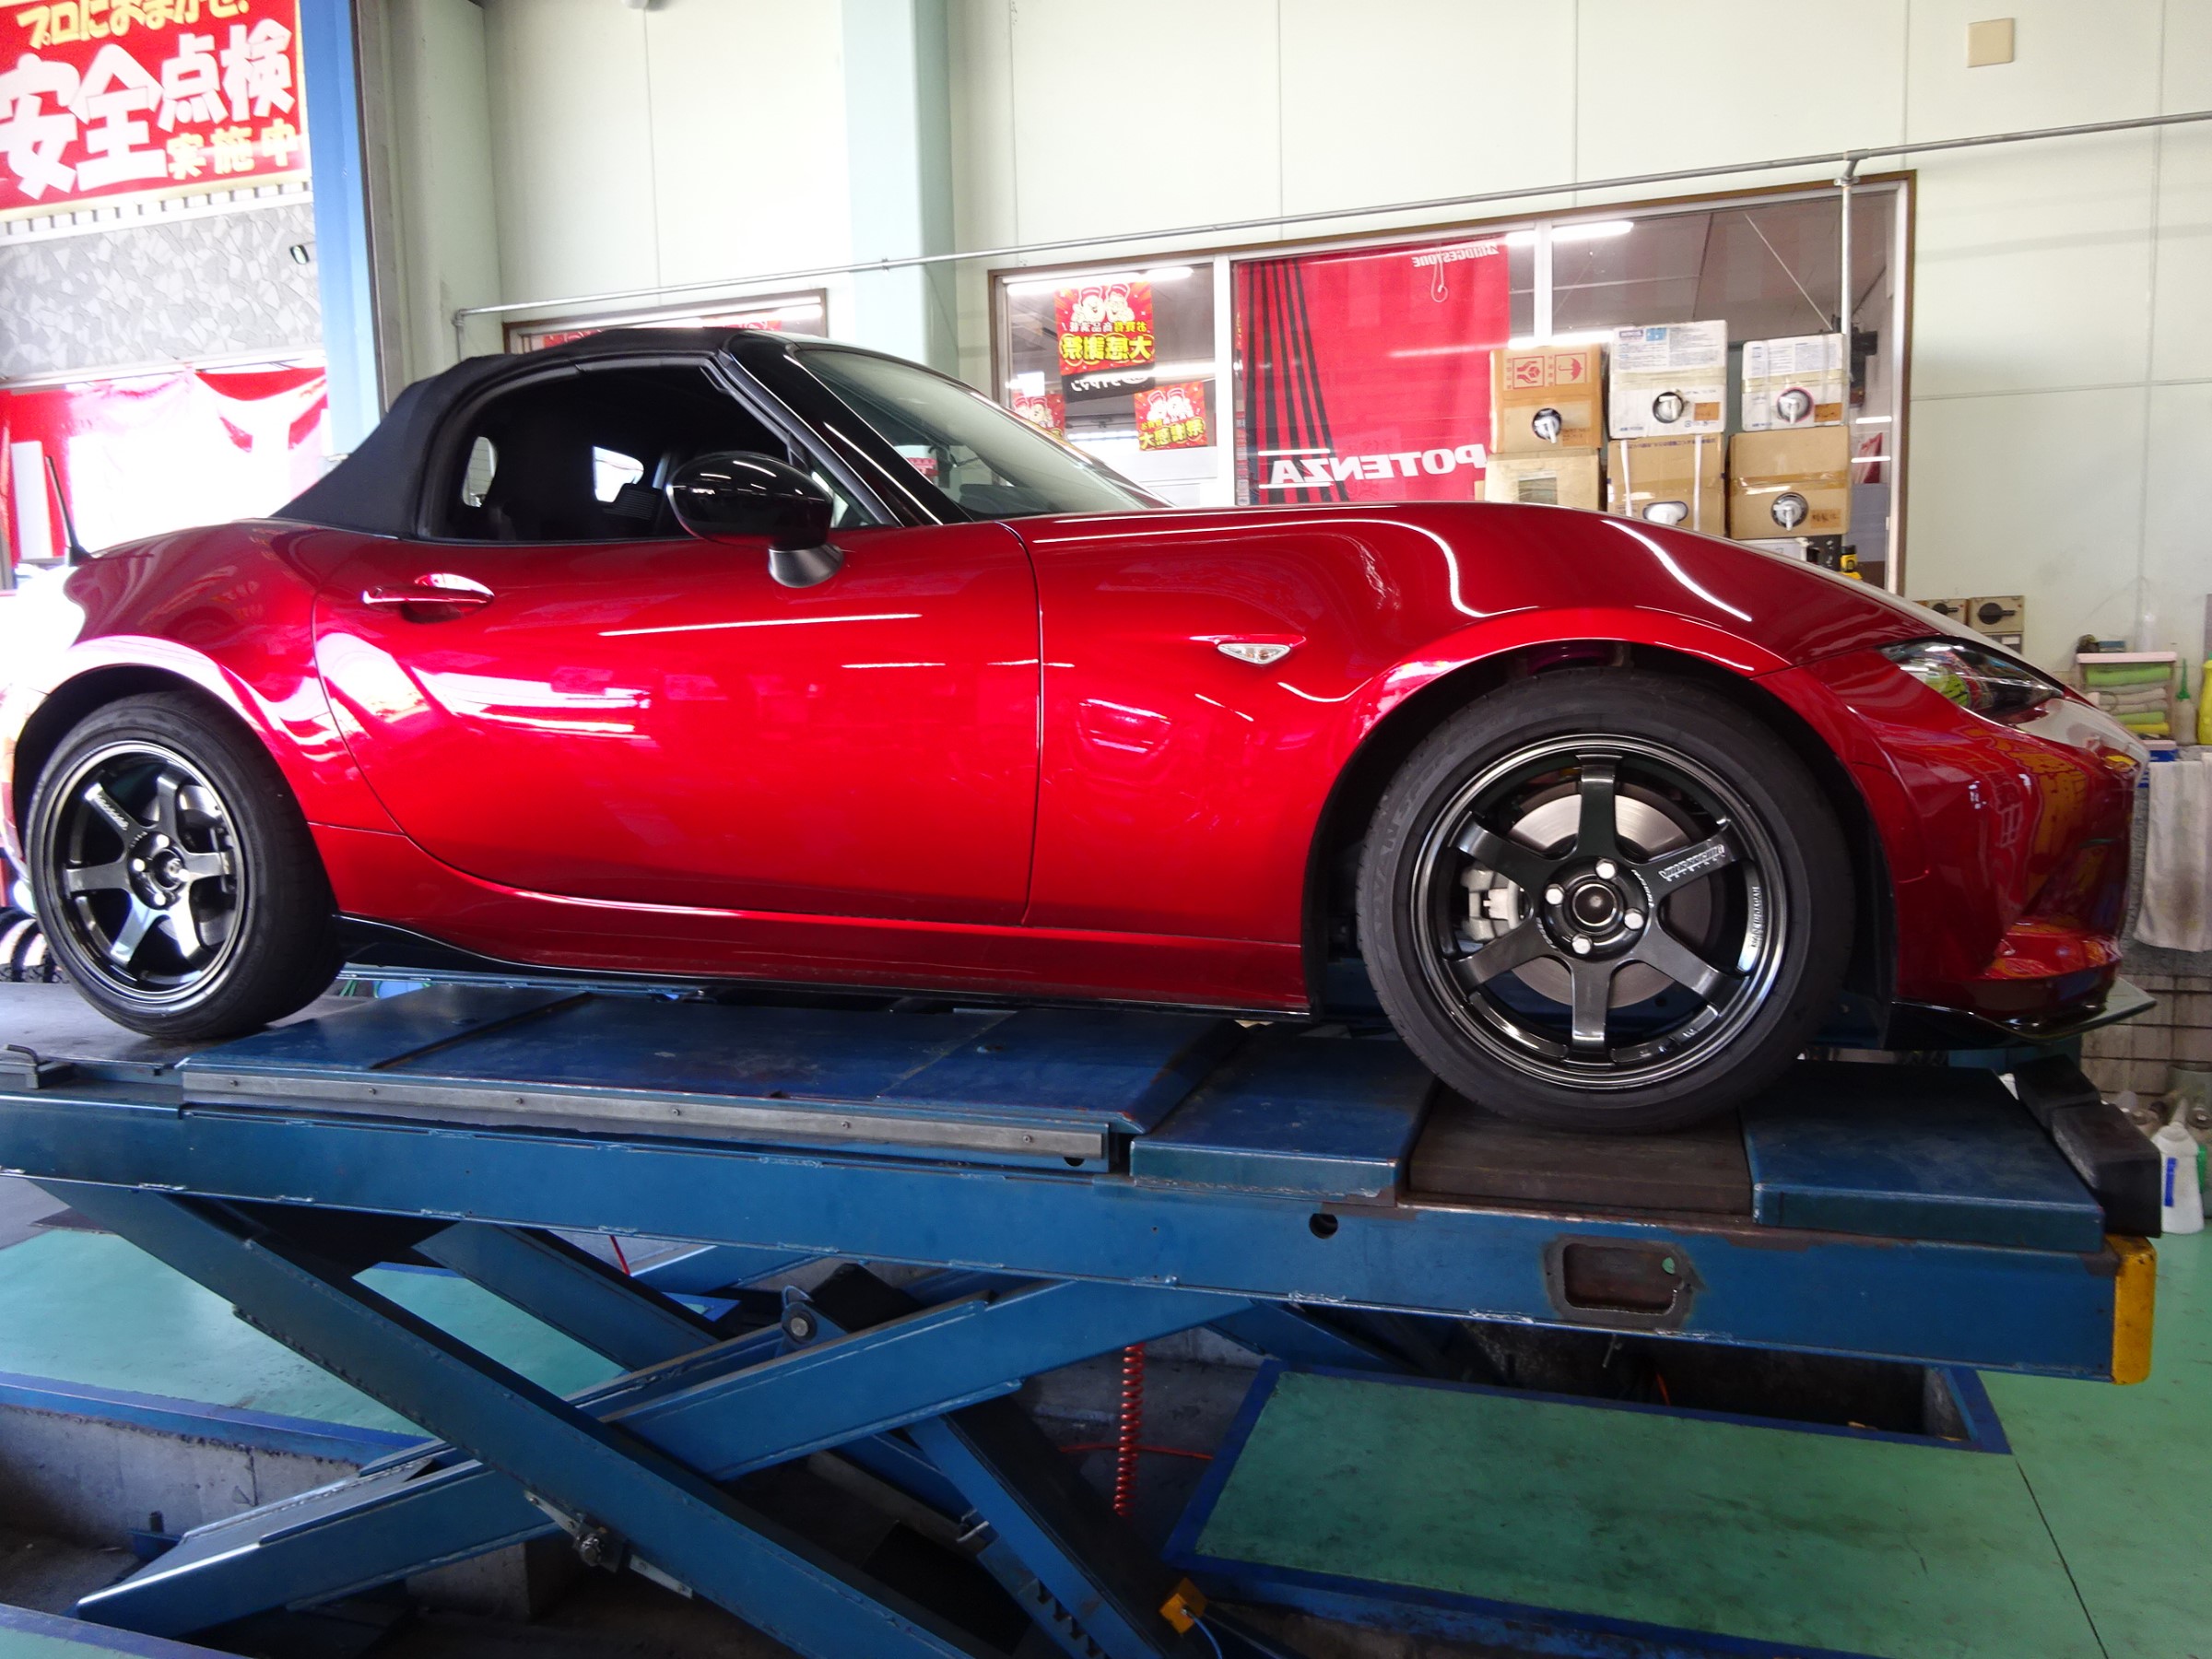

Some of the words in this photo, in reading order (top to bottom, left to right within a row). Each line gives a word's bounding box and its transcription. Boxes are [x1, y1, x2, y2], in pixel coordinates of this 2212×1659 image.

[0, 18, 296, 200] 安全点検
[166, 118, 299, 180] 実施中
[1138, 418, 1205, 450] 大感謝祭
